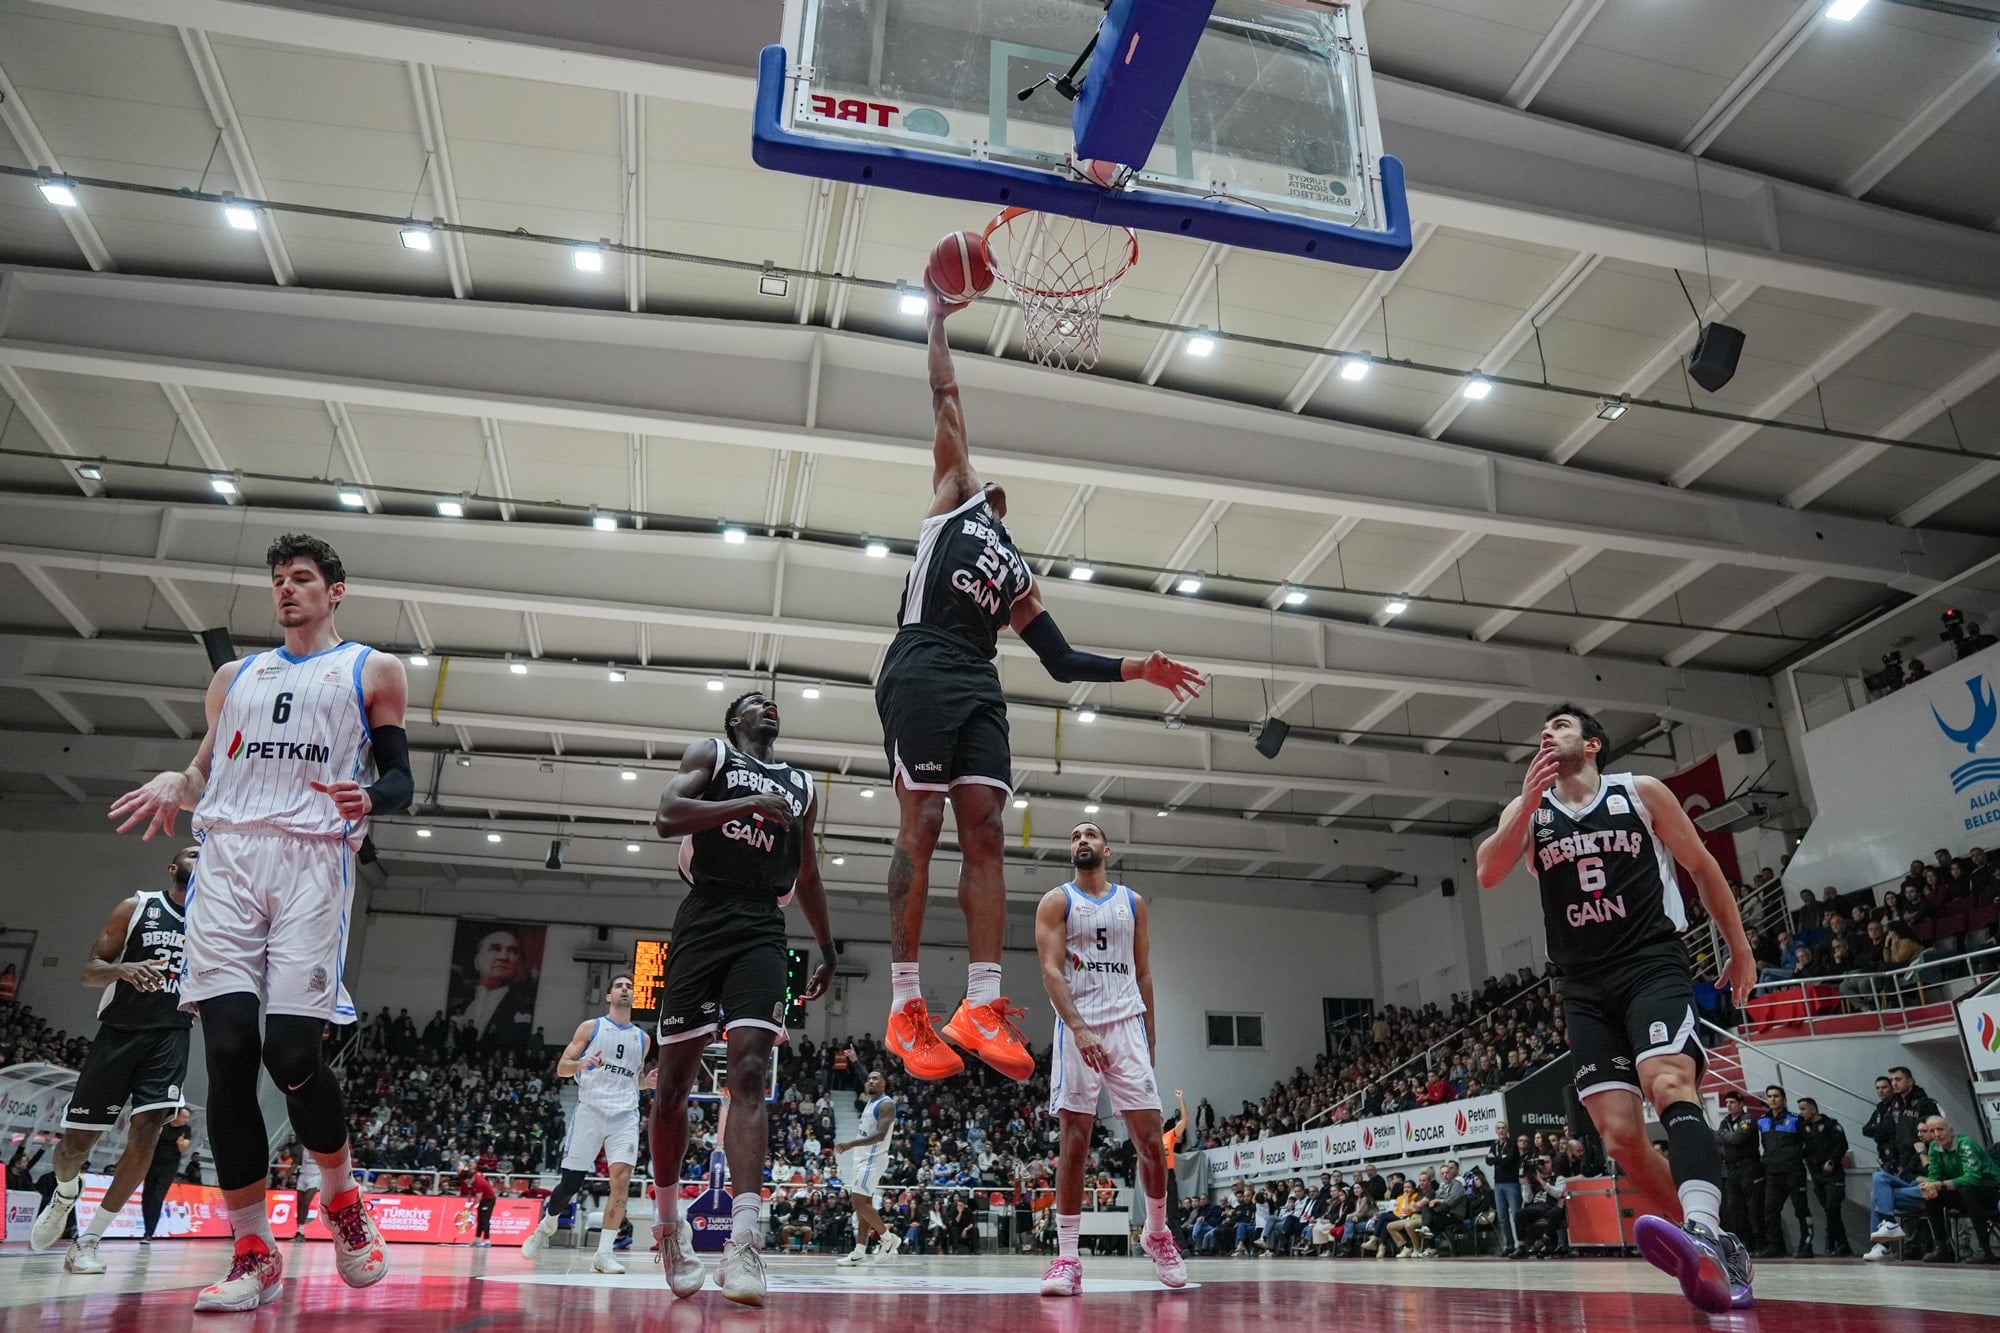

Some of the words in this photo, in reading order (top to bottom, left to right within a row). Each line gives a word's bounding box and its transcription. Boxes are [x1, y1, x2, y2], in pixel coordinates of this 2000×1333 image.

[976, 546, 1009, 591] 21
[272, 692, 294, 725] 6
[1970, 787, 2000, 810] ALİA
[1964, 808, 2000, 831] BELED
[1538, 830, 1642, 871] BEŞİKTAŞ
[1577, 856, 1607, 892] 6
[142, 930, 186, 948] BEŞİK
[1096, 928, 1107, 951] 5
[616, 1044, 625, 1060] 9
[1468, 1107, 1496, 1122] Petkim
[1374, 1125, 1396, 1138] Petkim
[1415, 1126, 1445, 1142] SOCAR
[1470, 1124, 1489, 1135] SPOR
[1333, 1140, 1356, 1155] SOCAR
[1266, 1151, 1286, 1165] SOCAR
[1212, 1161, 1228, 1173] SOCAR
[382, 1206, 432, 1219] TÜRKİYE
